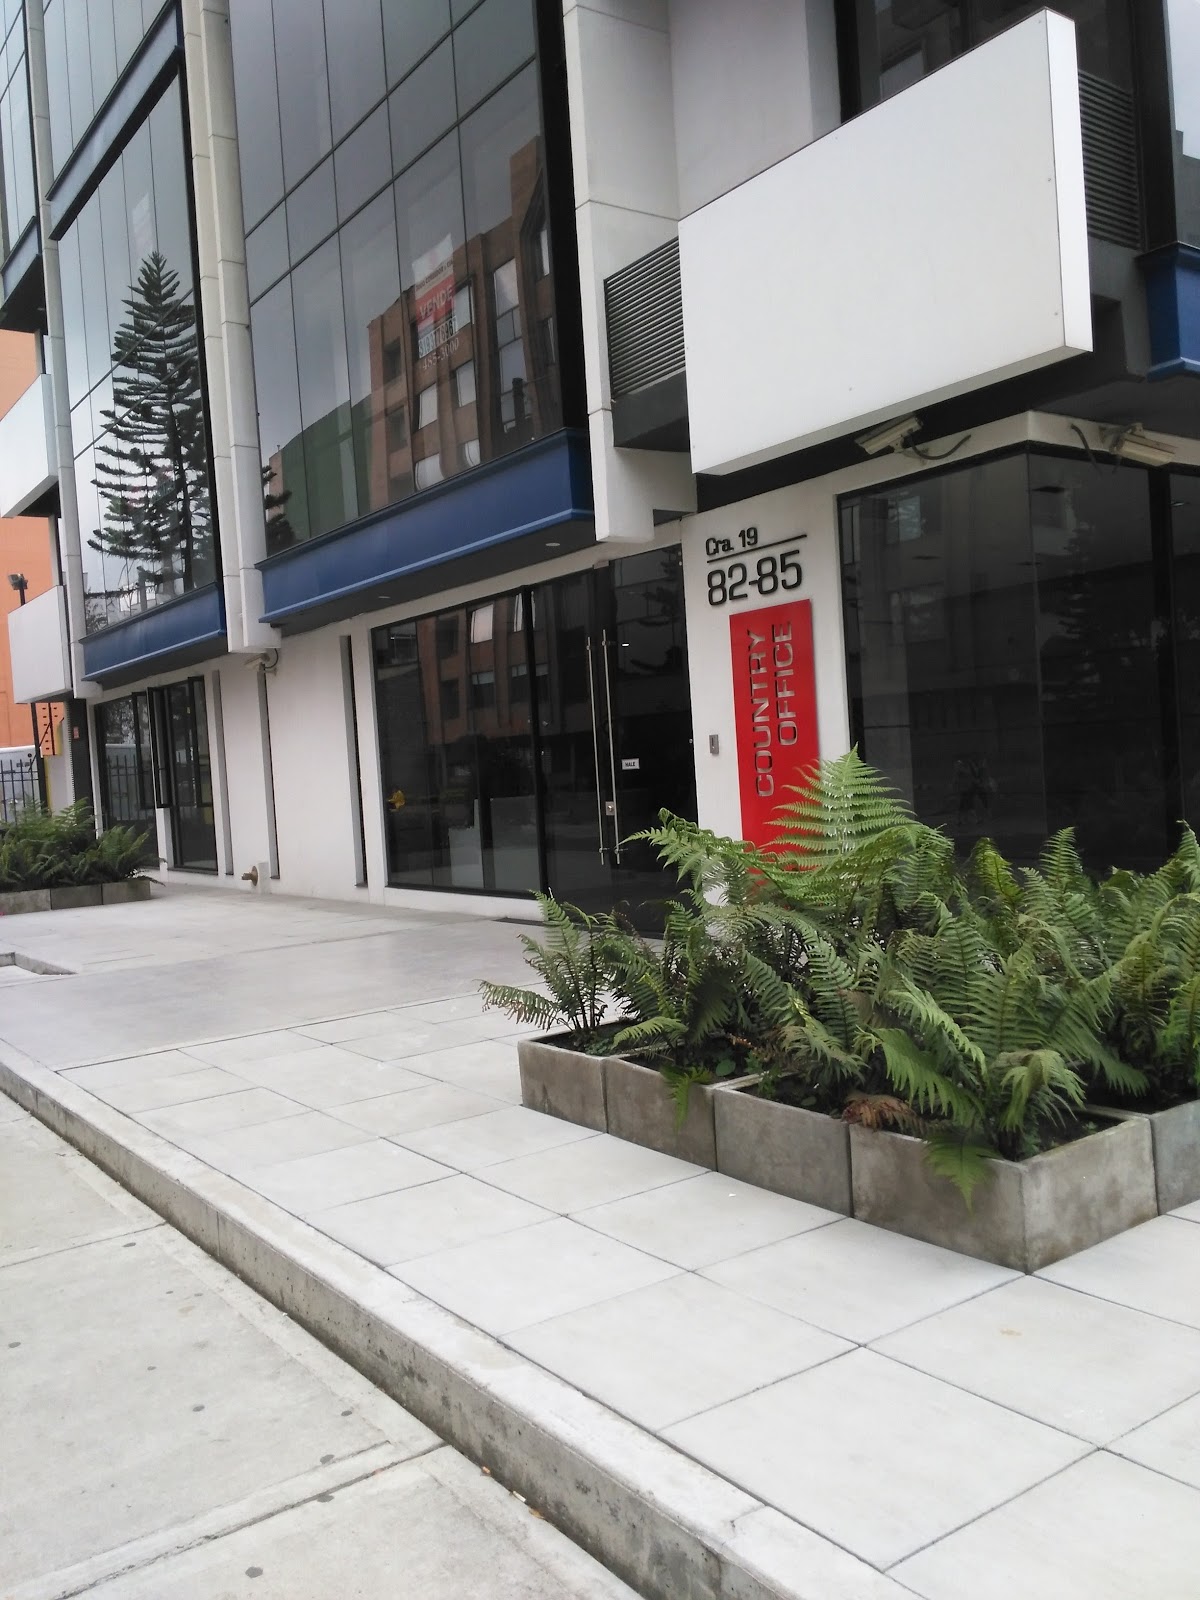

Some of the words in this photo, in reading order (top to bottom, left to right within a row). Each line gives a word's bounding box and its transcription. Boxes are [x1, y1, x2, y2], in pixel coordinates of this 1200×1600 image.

[420, 285, 453, 318] VENDE
[739, 527, 758, 548] 19
[707, 549, 803, 606] 82-85
[772, 621, 798, 746] OFFICE
[747, 630, 775, 797] COUNTRY
